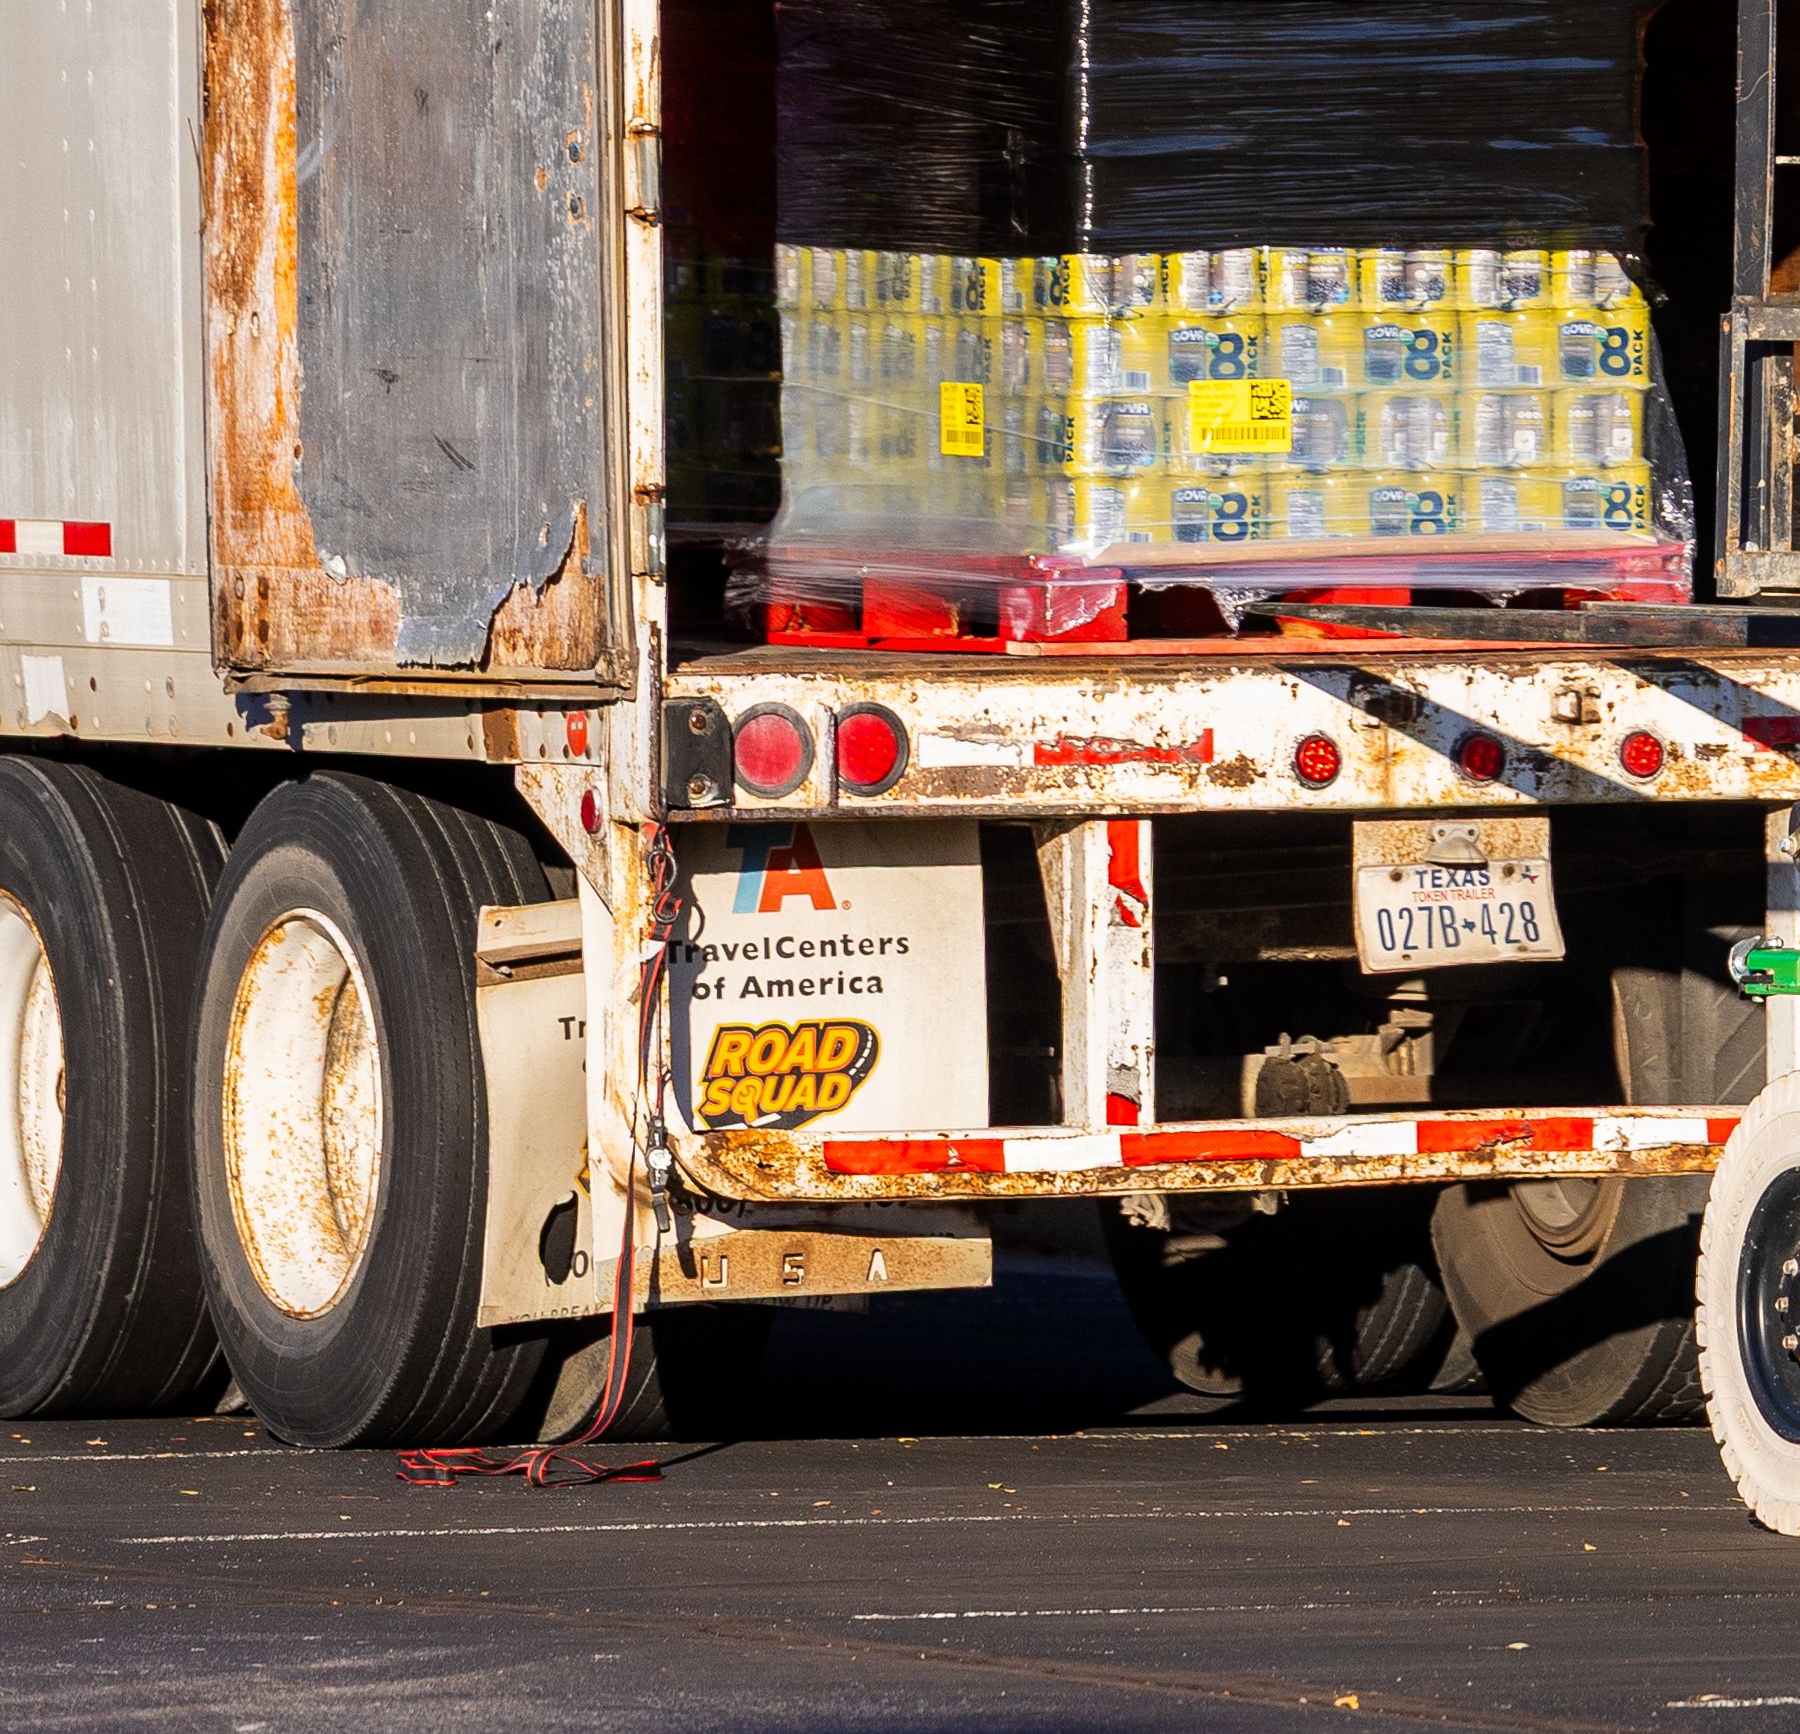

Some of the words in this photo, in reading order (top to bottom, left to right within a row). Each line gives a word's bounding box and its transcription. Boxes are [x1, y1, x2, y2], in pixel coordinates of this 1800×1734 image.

[1062, 259, 1071, 305] PACK
[1209, 332, 1246, 380] 8
[1404, 329, 1440, 380] 8
[1441, 332, 1453, 379] PACK
[1599, 327, 1632, 376] 8
[1633, 329, 1644, 376] PACK
[1212, 492, 1248, 541] 8
[1411, 491, 1445, 535] 8
[1604, 481, 1633, 530] 8
[1634, 484, 1646, 529] PACK
[1412, 891, 1448, 902] TOKEN
[1451, 888, 1496, 901] TRAILER
[1415, 869, 1491, 888] TEXAS
[667, 934, 909, 964] TravelCenters
[1377, 905, 1460, 951] 027B
[1481, 901, 1540, 945] 428
[692, 977, 726, 999] of
[740, 971, 884, 998] America
[708, 1026, 859, 1076] ROAD
[701, 1073, 852, 1125] SQUAD
